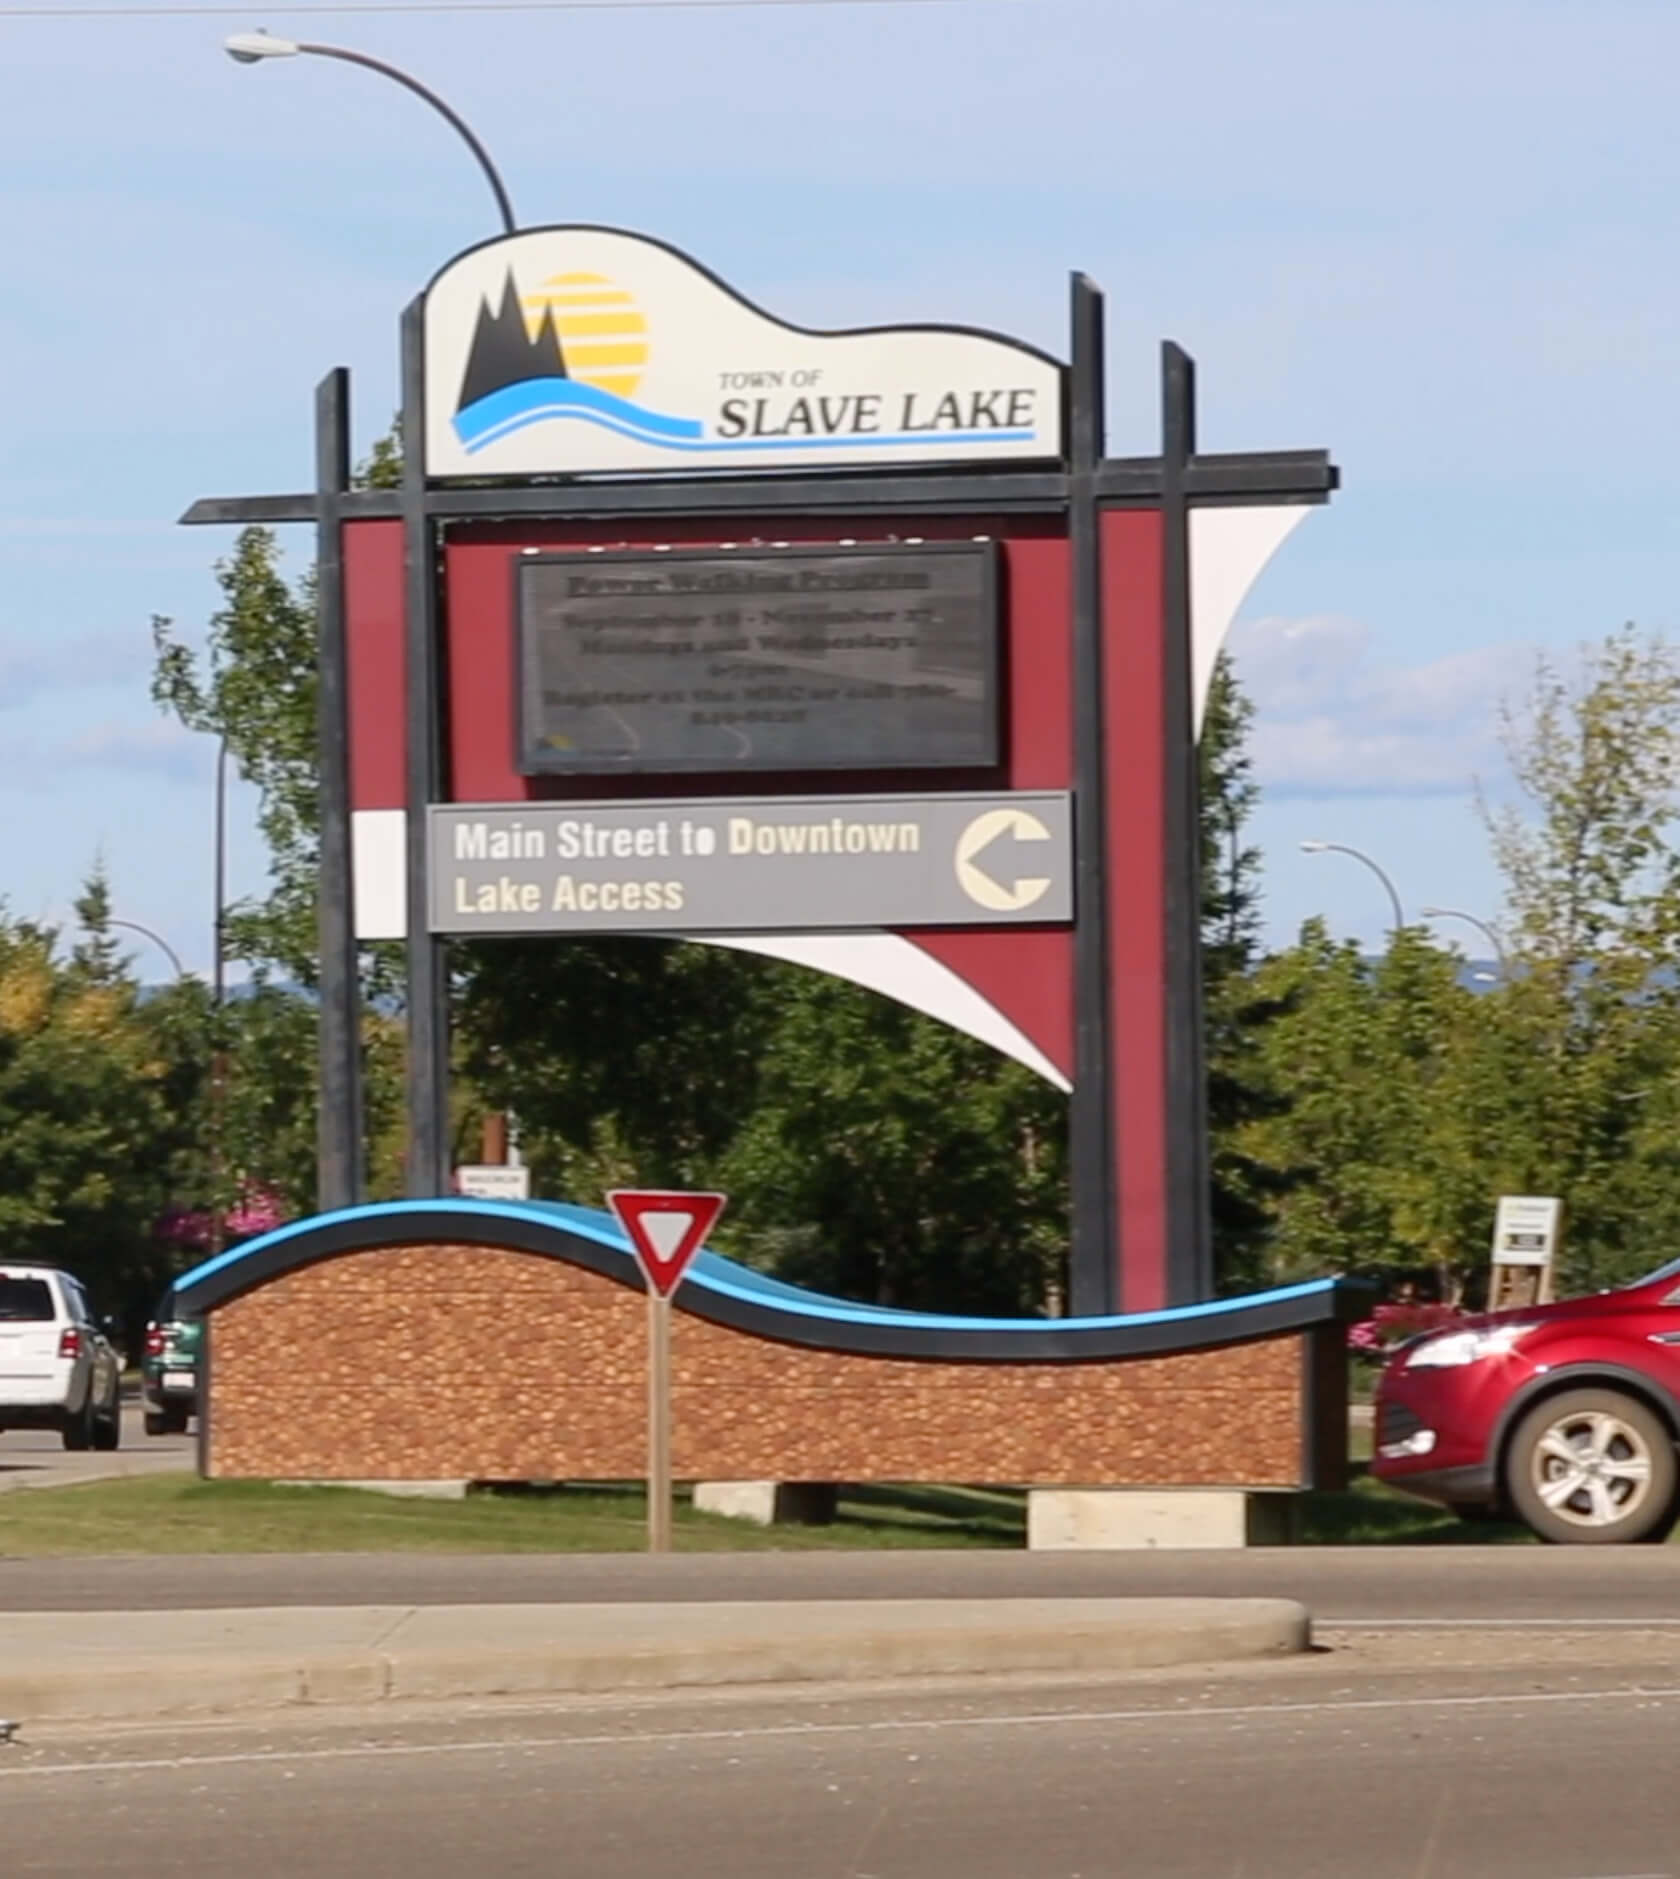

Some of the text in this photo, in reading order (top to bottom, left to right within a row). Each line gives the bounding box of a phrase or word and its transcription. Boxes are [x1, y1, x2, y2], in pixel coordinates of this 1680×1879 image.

[718, 369, 823, 390] TOWN OF
[716, 388, 1037, 439] SLAVE LAKE
[668, 572, 792, 592] Walking
[798, 570, 930, 591] Program
[562, 612, 704, 632] September
[761, 608, 896, 625] November
[580, 634, 918, 658] Mondays and Wednesdays
[544, 689, 653, 707] Register
[658, 689, 685, 703] at
[691, 688, 736, 703] the
[810, 688, 840, 701] or
[846, 684, 894, 699] call
[455, 818, 920, 859] Main Street to Downtown
[455, 876, 684, 913] Lake Access
